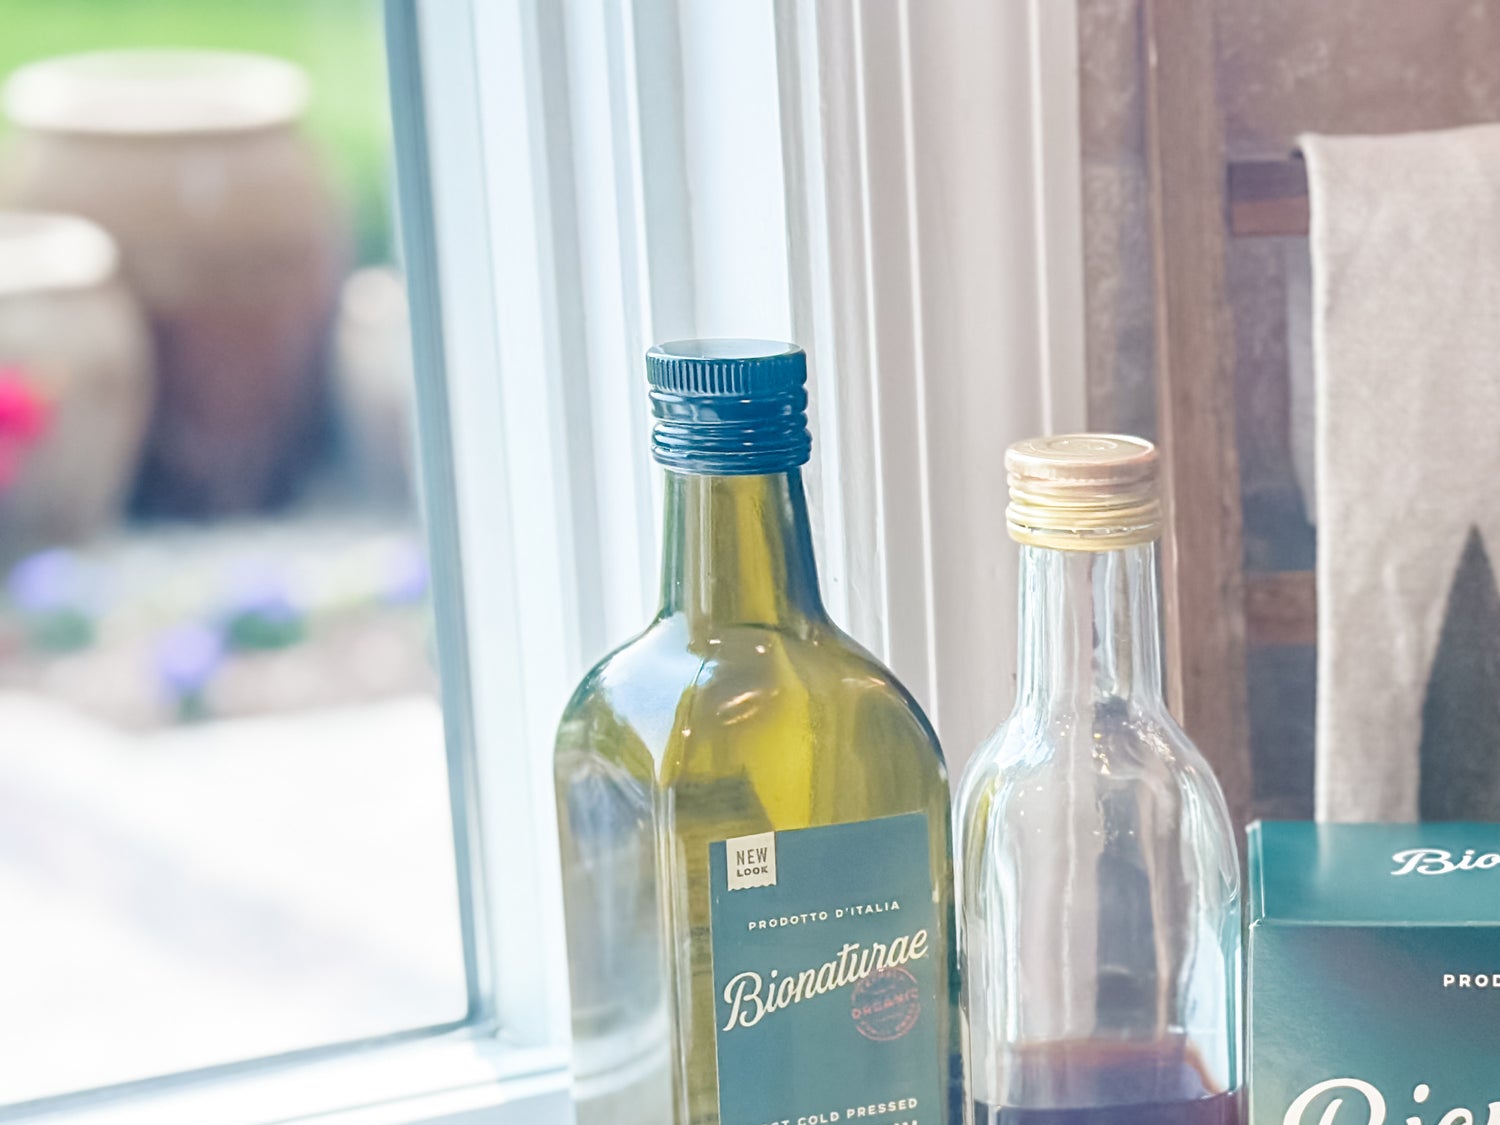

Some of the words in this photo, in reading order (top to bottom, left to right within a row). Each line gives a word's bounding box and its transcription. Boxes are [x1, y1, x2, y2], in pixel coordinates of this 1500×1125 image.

[736, 847, 768, 866] NEW
[736, 865, 768, 877] LOOK
[748, 911, 828, 931] PRODOTTO
[835, 900, 900, 918] D'ITALIA
[722, 929, 928, 1031] Bionaturae
[846, 1098, 918, 1119] PRESSED
